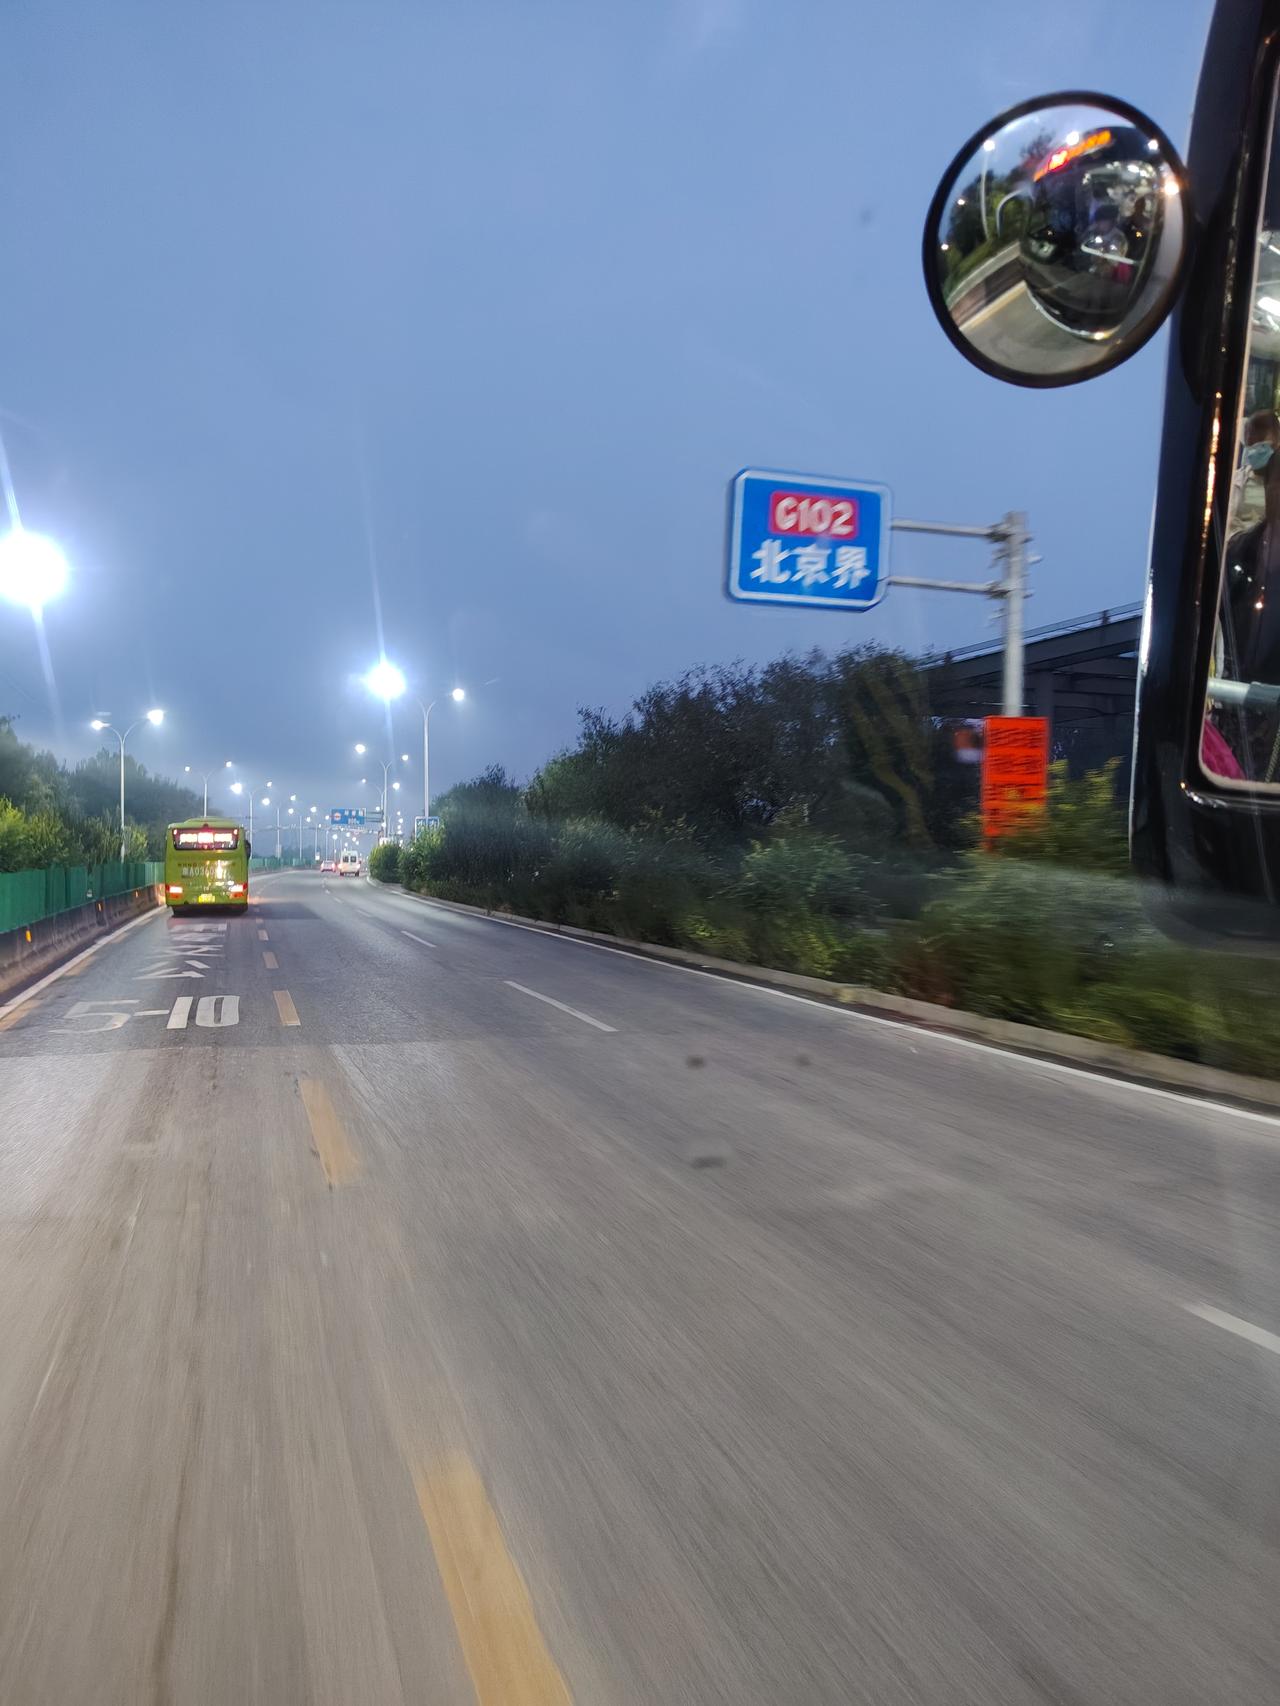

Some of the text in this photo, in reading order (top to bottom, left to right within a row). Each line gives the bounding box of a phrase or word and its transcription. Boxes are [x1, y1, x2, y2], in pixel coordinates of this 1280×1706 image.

[775, 496, 854, 535] G102
[750, 538, 871, 589] 北京界
